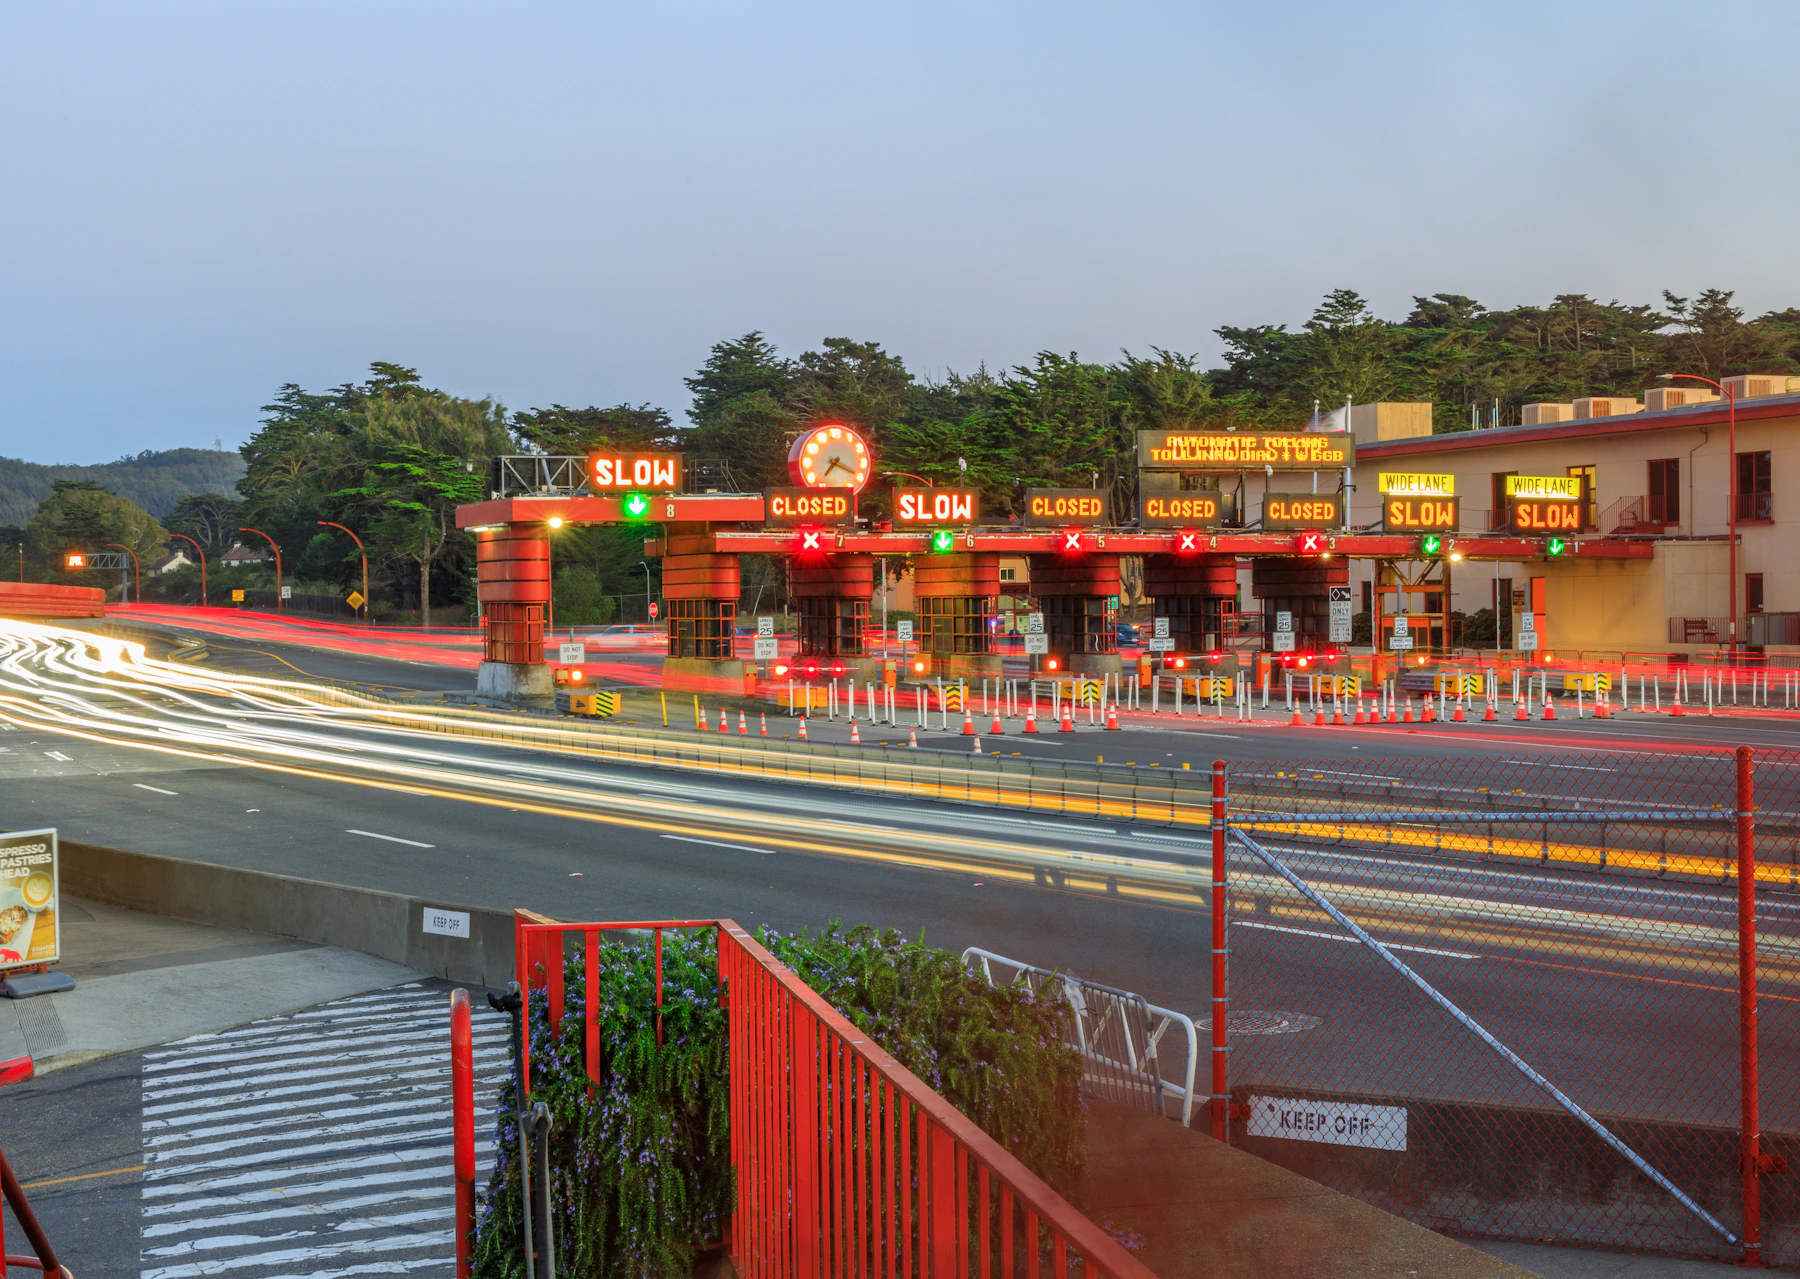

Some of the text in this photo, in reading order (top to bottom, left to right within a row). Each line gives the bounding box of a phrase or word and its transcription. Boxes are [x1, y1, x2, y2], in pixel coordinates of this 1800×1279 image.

[596, 459, 674, 486] SLOW
[1386, 475, 1448, 492] WIDE LANE
[1514, 478, 1574, 495] WIDE LANE
[666, 504, 675, 518] 8
[772, 497, 846, 515] CLOSED
[900, 494, 972, 519] SLOW
[1032, 498, 1102, 516] CLOSED
[1148, 500, 1215, 518] CLOSED
[1270, 502, 1334, 520] CLOSED
[1390, 502, 1453, 526] SLOW
[1518, 504, 1578, 528] SLOW
[836, 534, 844, 548] 7
[966, 534, 974, 548] 6
[1098, 536, 1106, 548] 5
[1210, 536, 1218, 548] 4
[1328, 537, 1336, 550] 3
[1448, 538, 1455, 551] 2
[1574, 540, 1579, 553] 1
[1, 853, 52, 868] PASTRIES
[433, 916, 460, 930] KEEP OFF
[1281, 1110, 1370, 1136] KEEP OFF
